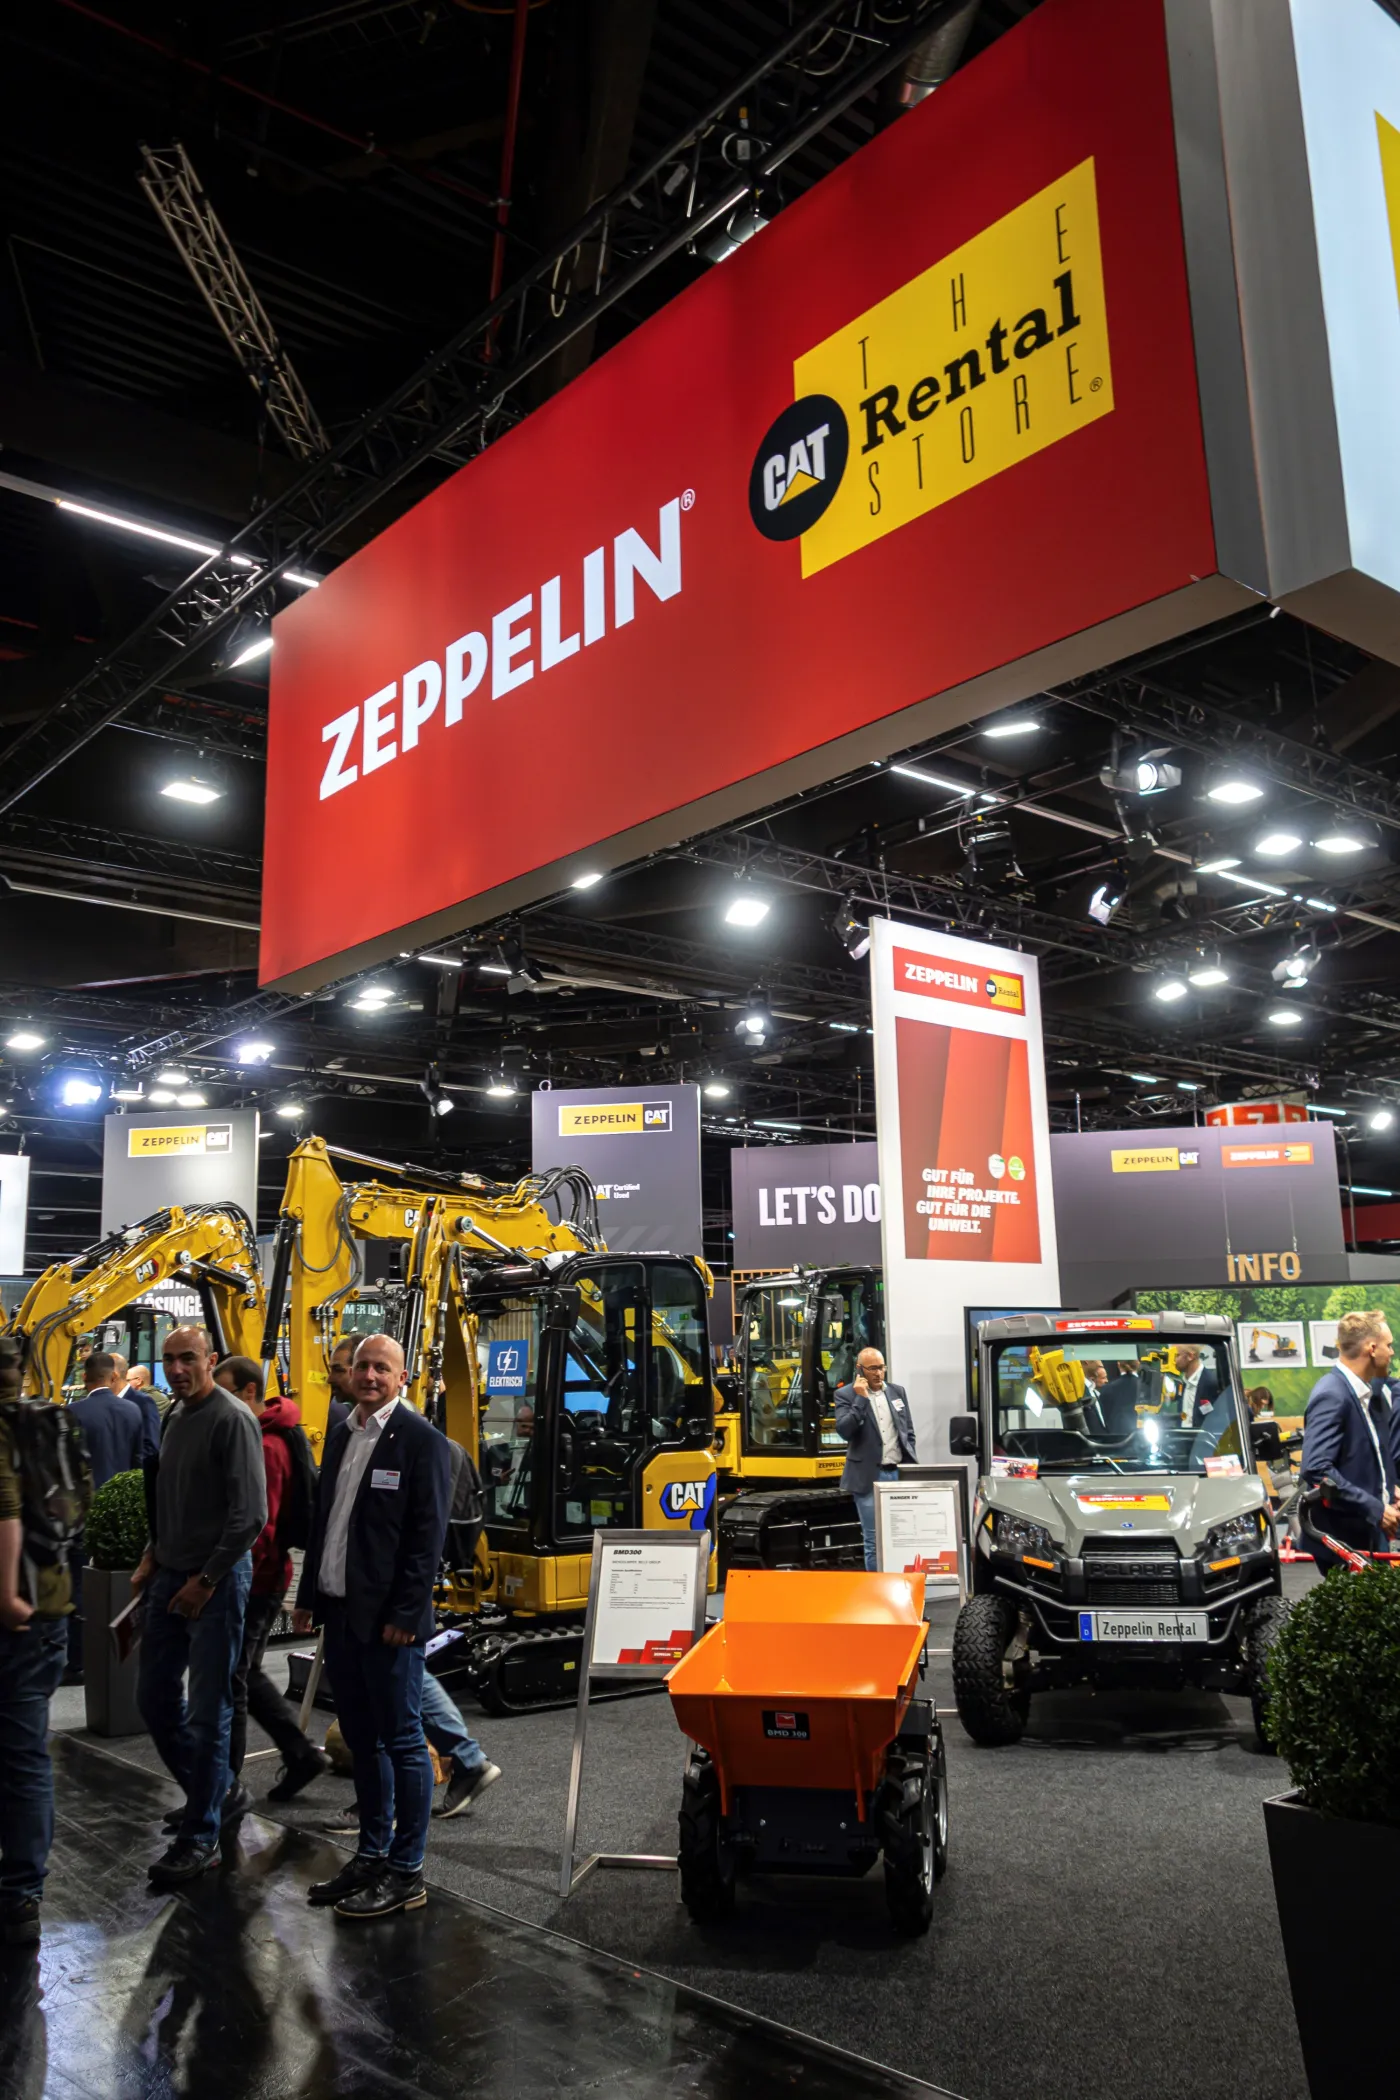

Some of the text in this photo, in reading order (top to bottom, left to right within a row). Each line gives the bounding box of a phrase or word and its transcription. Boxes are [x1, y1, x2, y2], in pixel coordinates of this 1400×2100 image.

[861, 270, 1081, 455] Rental
[763, 423, 830, 511] CAT
[904, 962, 978, 993] ZEPPELIN
[574, 1109, 668, 1125] ZEPPELIN CAT
[142, 1136, 199, 1147] ZEPPELIN
[1123, 1152, 1199, 1165] ZEPPELIN CAT
[922, 1168, 974, 1185] GUT FÜR
[842, 1183, 882, 1223] DO
[927, 1185, 1021, 1204] IHRE PROJEKTE.
[916, 1199, 991, 1218] GUT FÜR DIE
[404, 1209, 420, 1227] CA
[928, 1218, 982, 1233] UMWELT.
[135, 1259, 155, 1284] CAT
[1227, 1252, 1301, 1282] INFO
[489, 1376, 523, 1387] ELEKTRISCH
[671, 1482, 706, 1510] CAT
[1090, 1563, 1176, 1577] POLARIS
[1103, 1621, 1197, 1638] Zeppelin Rental
